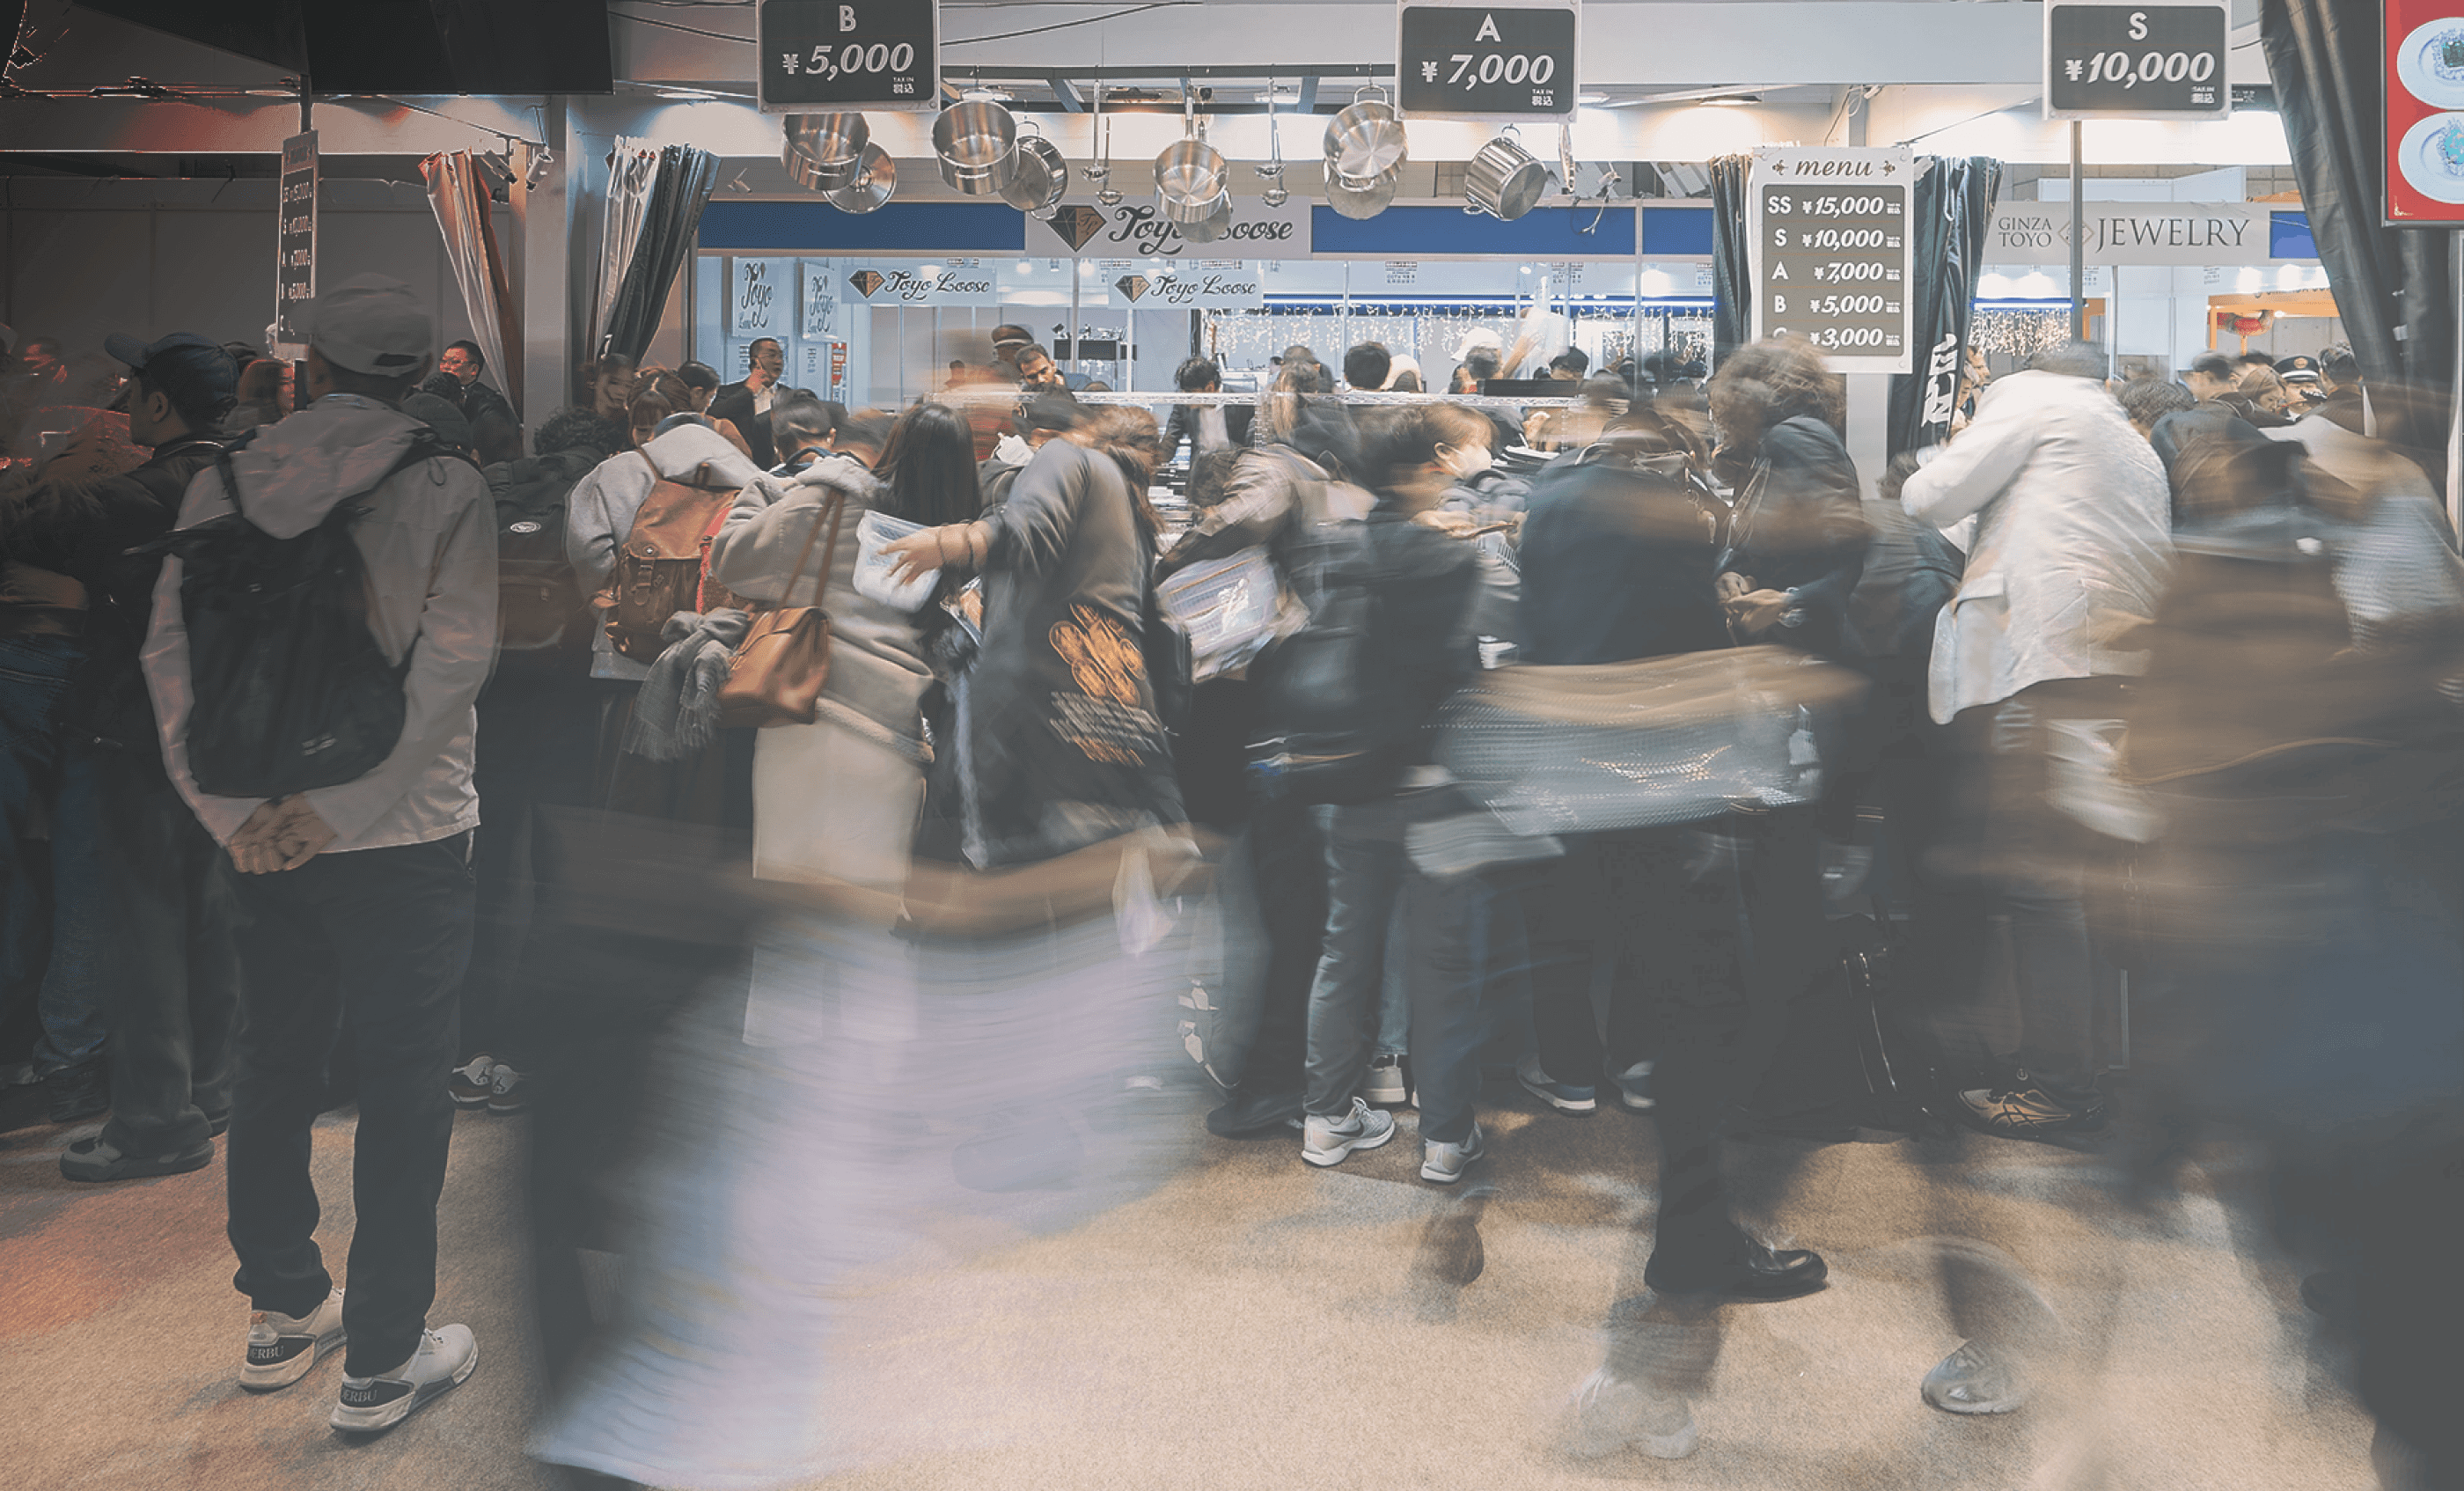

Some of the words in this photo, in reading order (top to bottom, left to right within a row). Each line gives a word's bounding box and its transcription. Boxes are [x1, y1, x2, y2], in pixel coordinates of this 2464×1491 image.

[839, 4, 857, 32] B
[1474, 12, 1501, 43] A
[2128, 11, 2149, 40] S
[2064, 51, 2216, 90] ¥10,000
[1795, 160, 1874, 177] menu
[1767, 195, 1793, 215] SS
[1802, 196, 1884, 219] ¥15,000
[1998, 217, 2052, 231] GINZA
[2095, 217, 2251, 254] JEWELRY
[1774, 228, 1787, 247] S
[1802, 229, 1884, 252] ¥10,000
[1998, 231, 2052, 248] TOYO
[1771, 261, 1789, 280] A
[1814, 261, 1884, 284] ¥7,000
[884, 270, 932, 301] Toyo
[935, 272, 991, 293] Loose
[1150, 275, 1199, 305] Toyo
[1201, 275, 1257, 296] Loose
[1774, 295, 1787, 313] B
[1809, 295, 1884, 318] ¥5,000
[1809, 327, 1883, 350] ¥3,000
